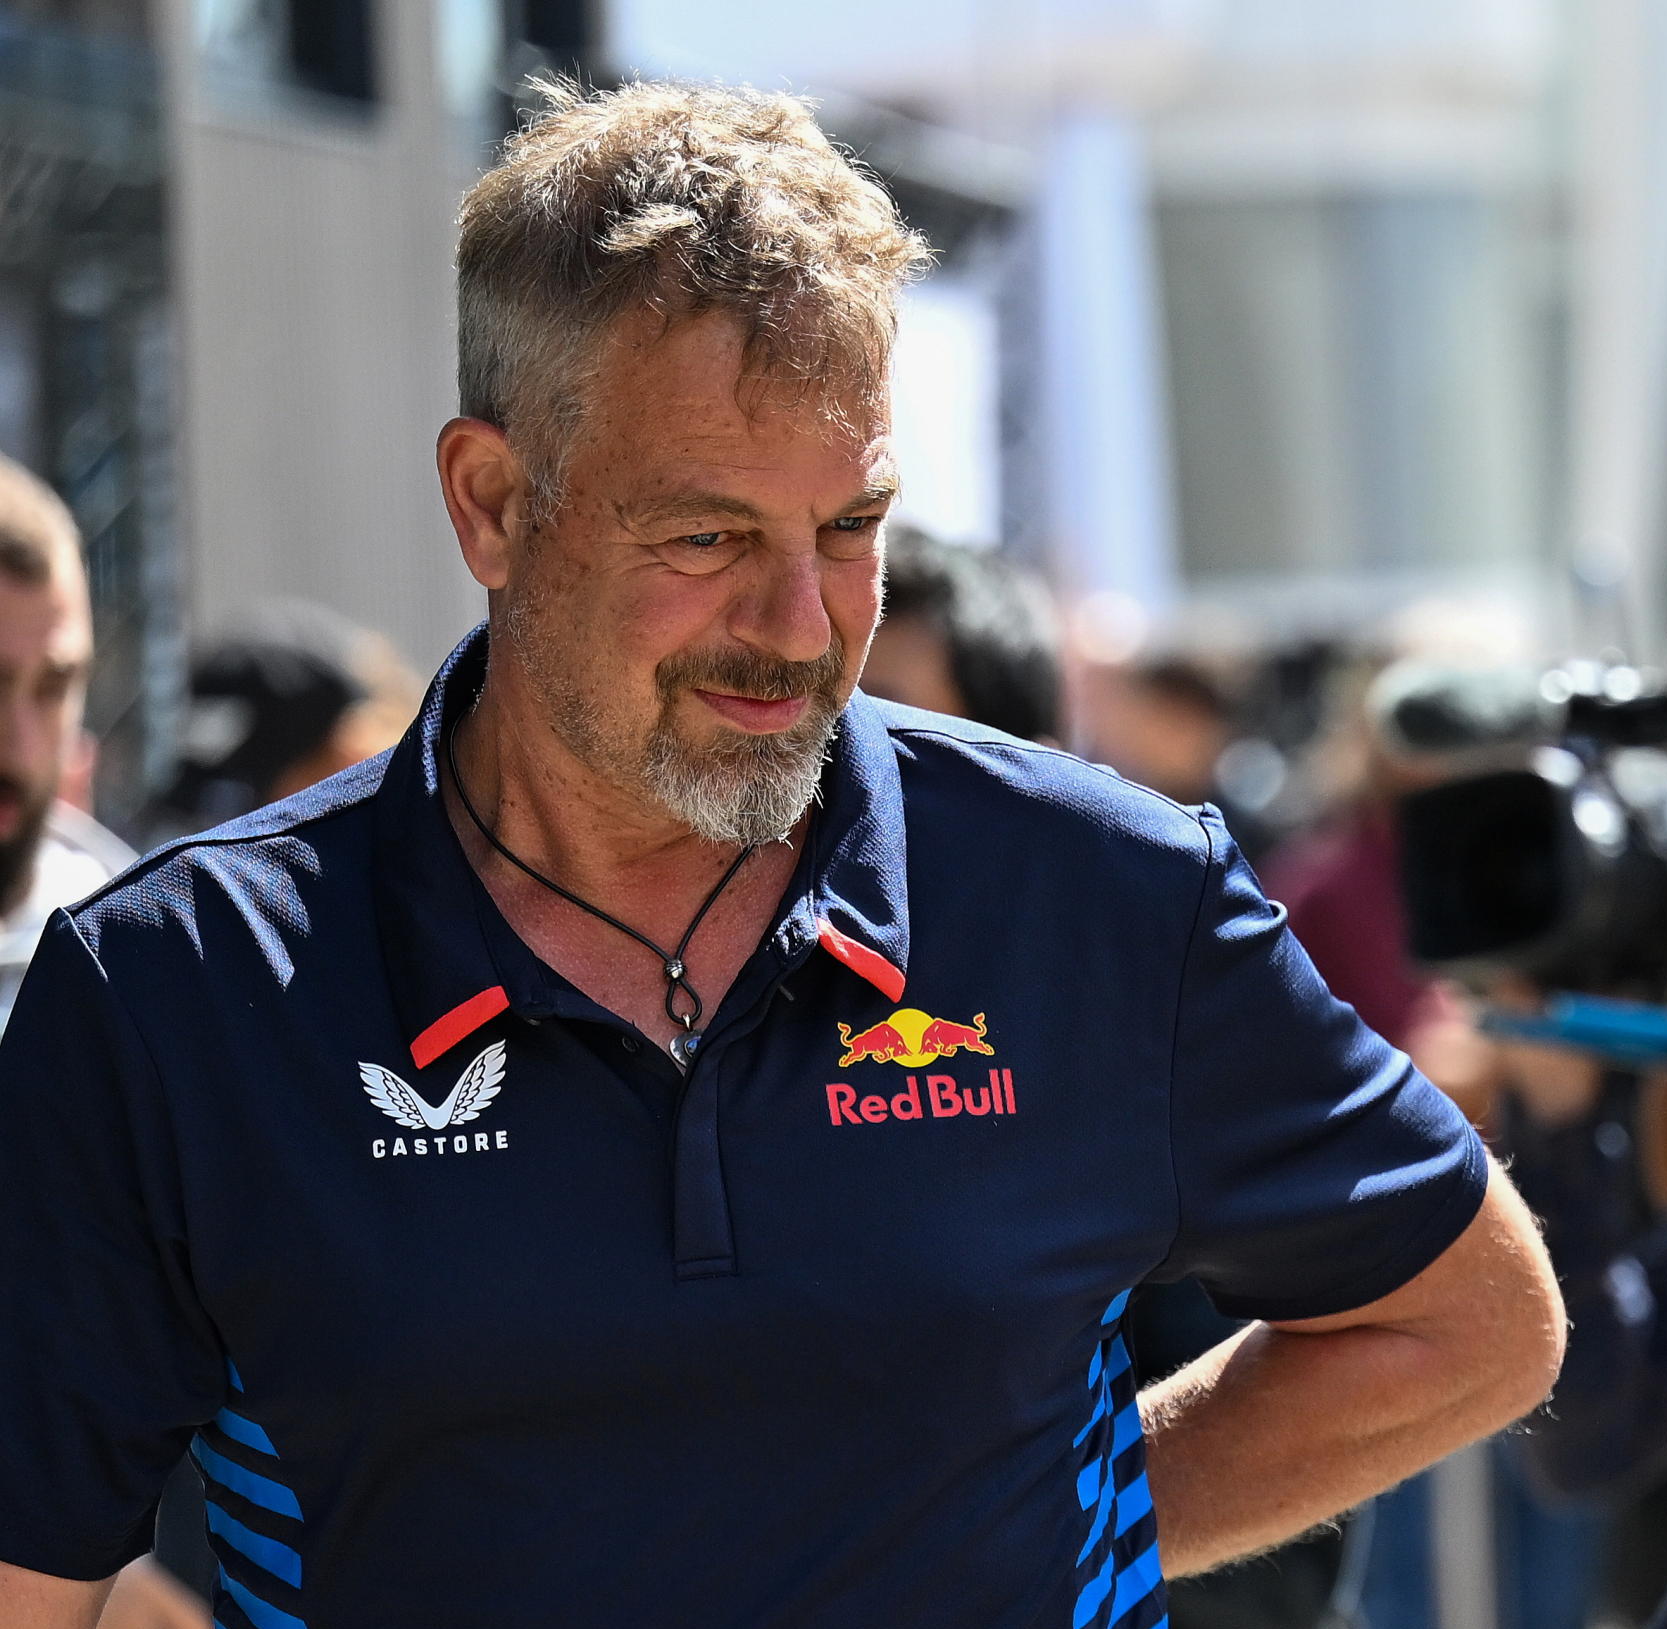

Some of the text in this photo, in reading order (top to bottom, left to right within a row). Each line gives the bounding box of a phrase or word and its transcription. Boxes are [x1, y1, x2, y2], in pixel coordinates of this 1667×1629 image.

[826, 1068, 1017, 1126] Red Bull
[372, 1130, 508, 1159] CASTORE
